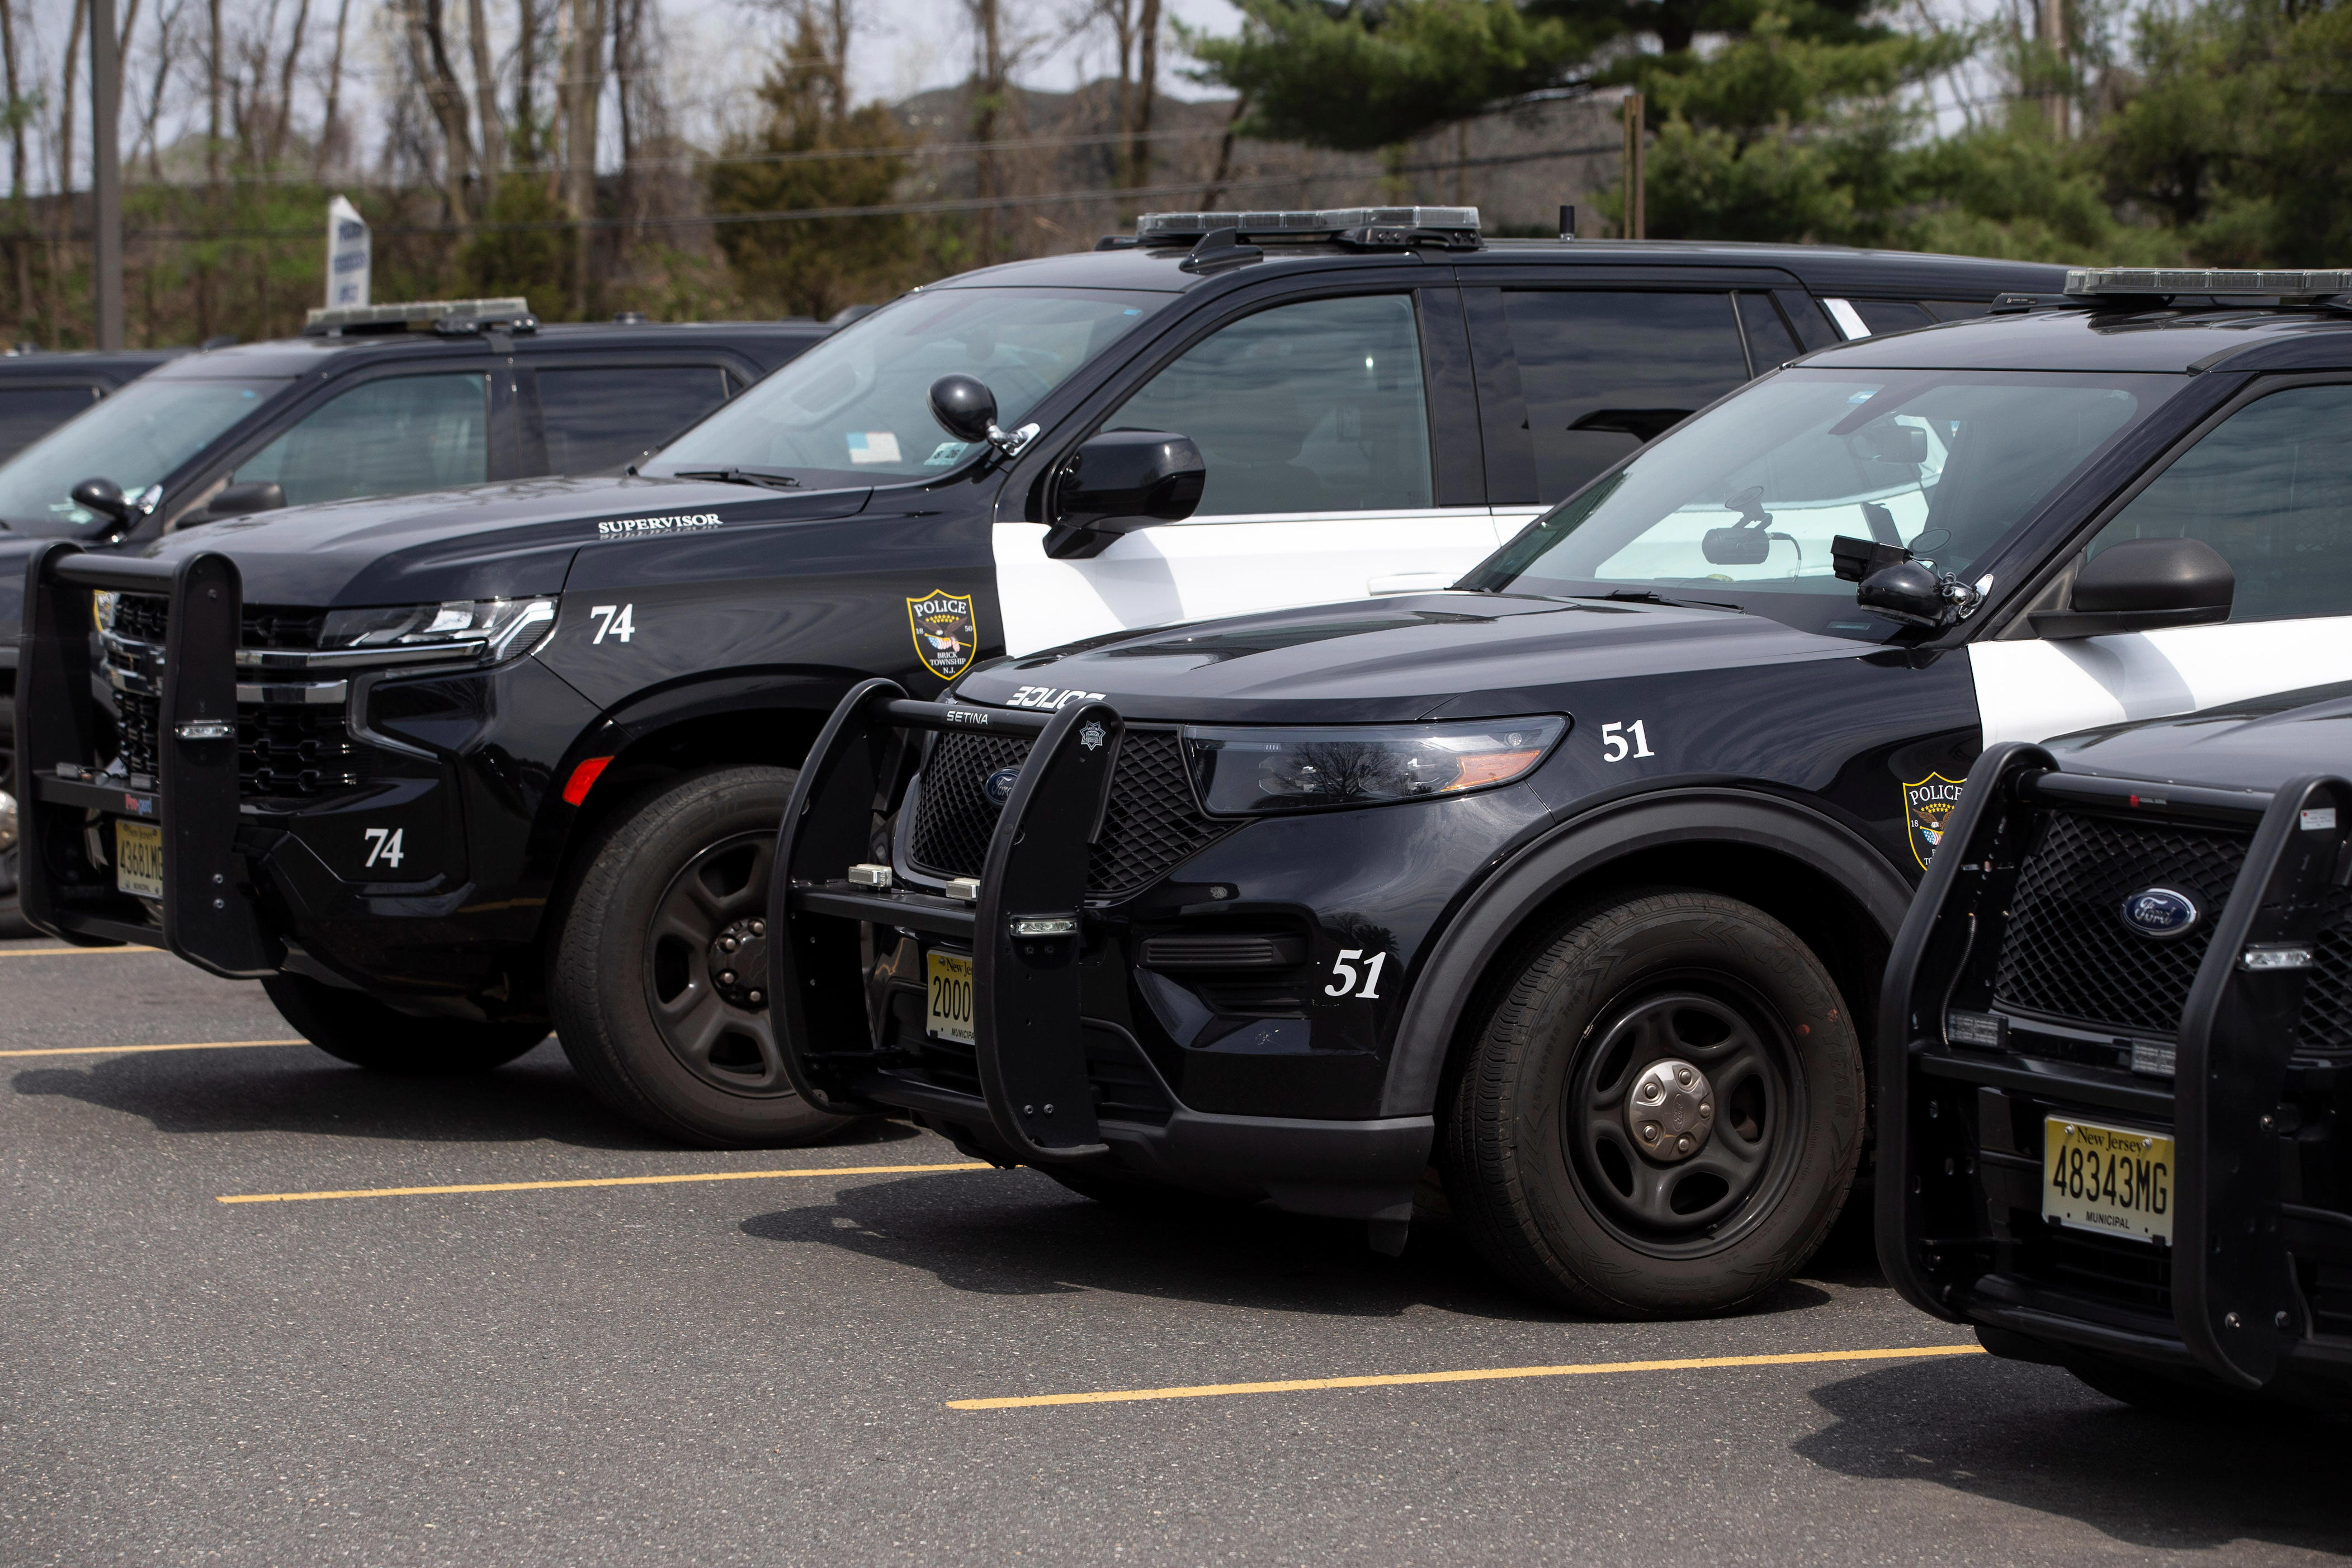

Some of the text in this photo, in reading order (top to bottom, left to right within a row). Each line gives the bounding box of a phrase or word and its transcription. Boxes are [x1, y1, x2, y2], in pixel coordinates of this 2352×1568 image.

[598, 513, 724, 533] SUPERVISOR
[913, 599, 967, 617] POLICE
[590, 603, 635, 644] 74
[929, 658, 966, 666] TOWNSHIP
[947, 710, 989, 725] SETINA
[1602, 719, 1655, 762] 51
[991, 776, 1013, 797] For
[365, 828, 404, 868] 74
[2134, 896, 2176, 925] Ford
[946, 958, 964, 973] New
[1324, 950, 1386, 999] 51
[933, 975, 971, 1023] 2000
[951, 1027, 975, 1041] MUNICIPA
[2077, 1126, 2143, 1157] New Jersey
[2053, 1145, 2167, 1215] 48343MG
[2085, 1210, 2131, 1230] MUNICIPAL
